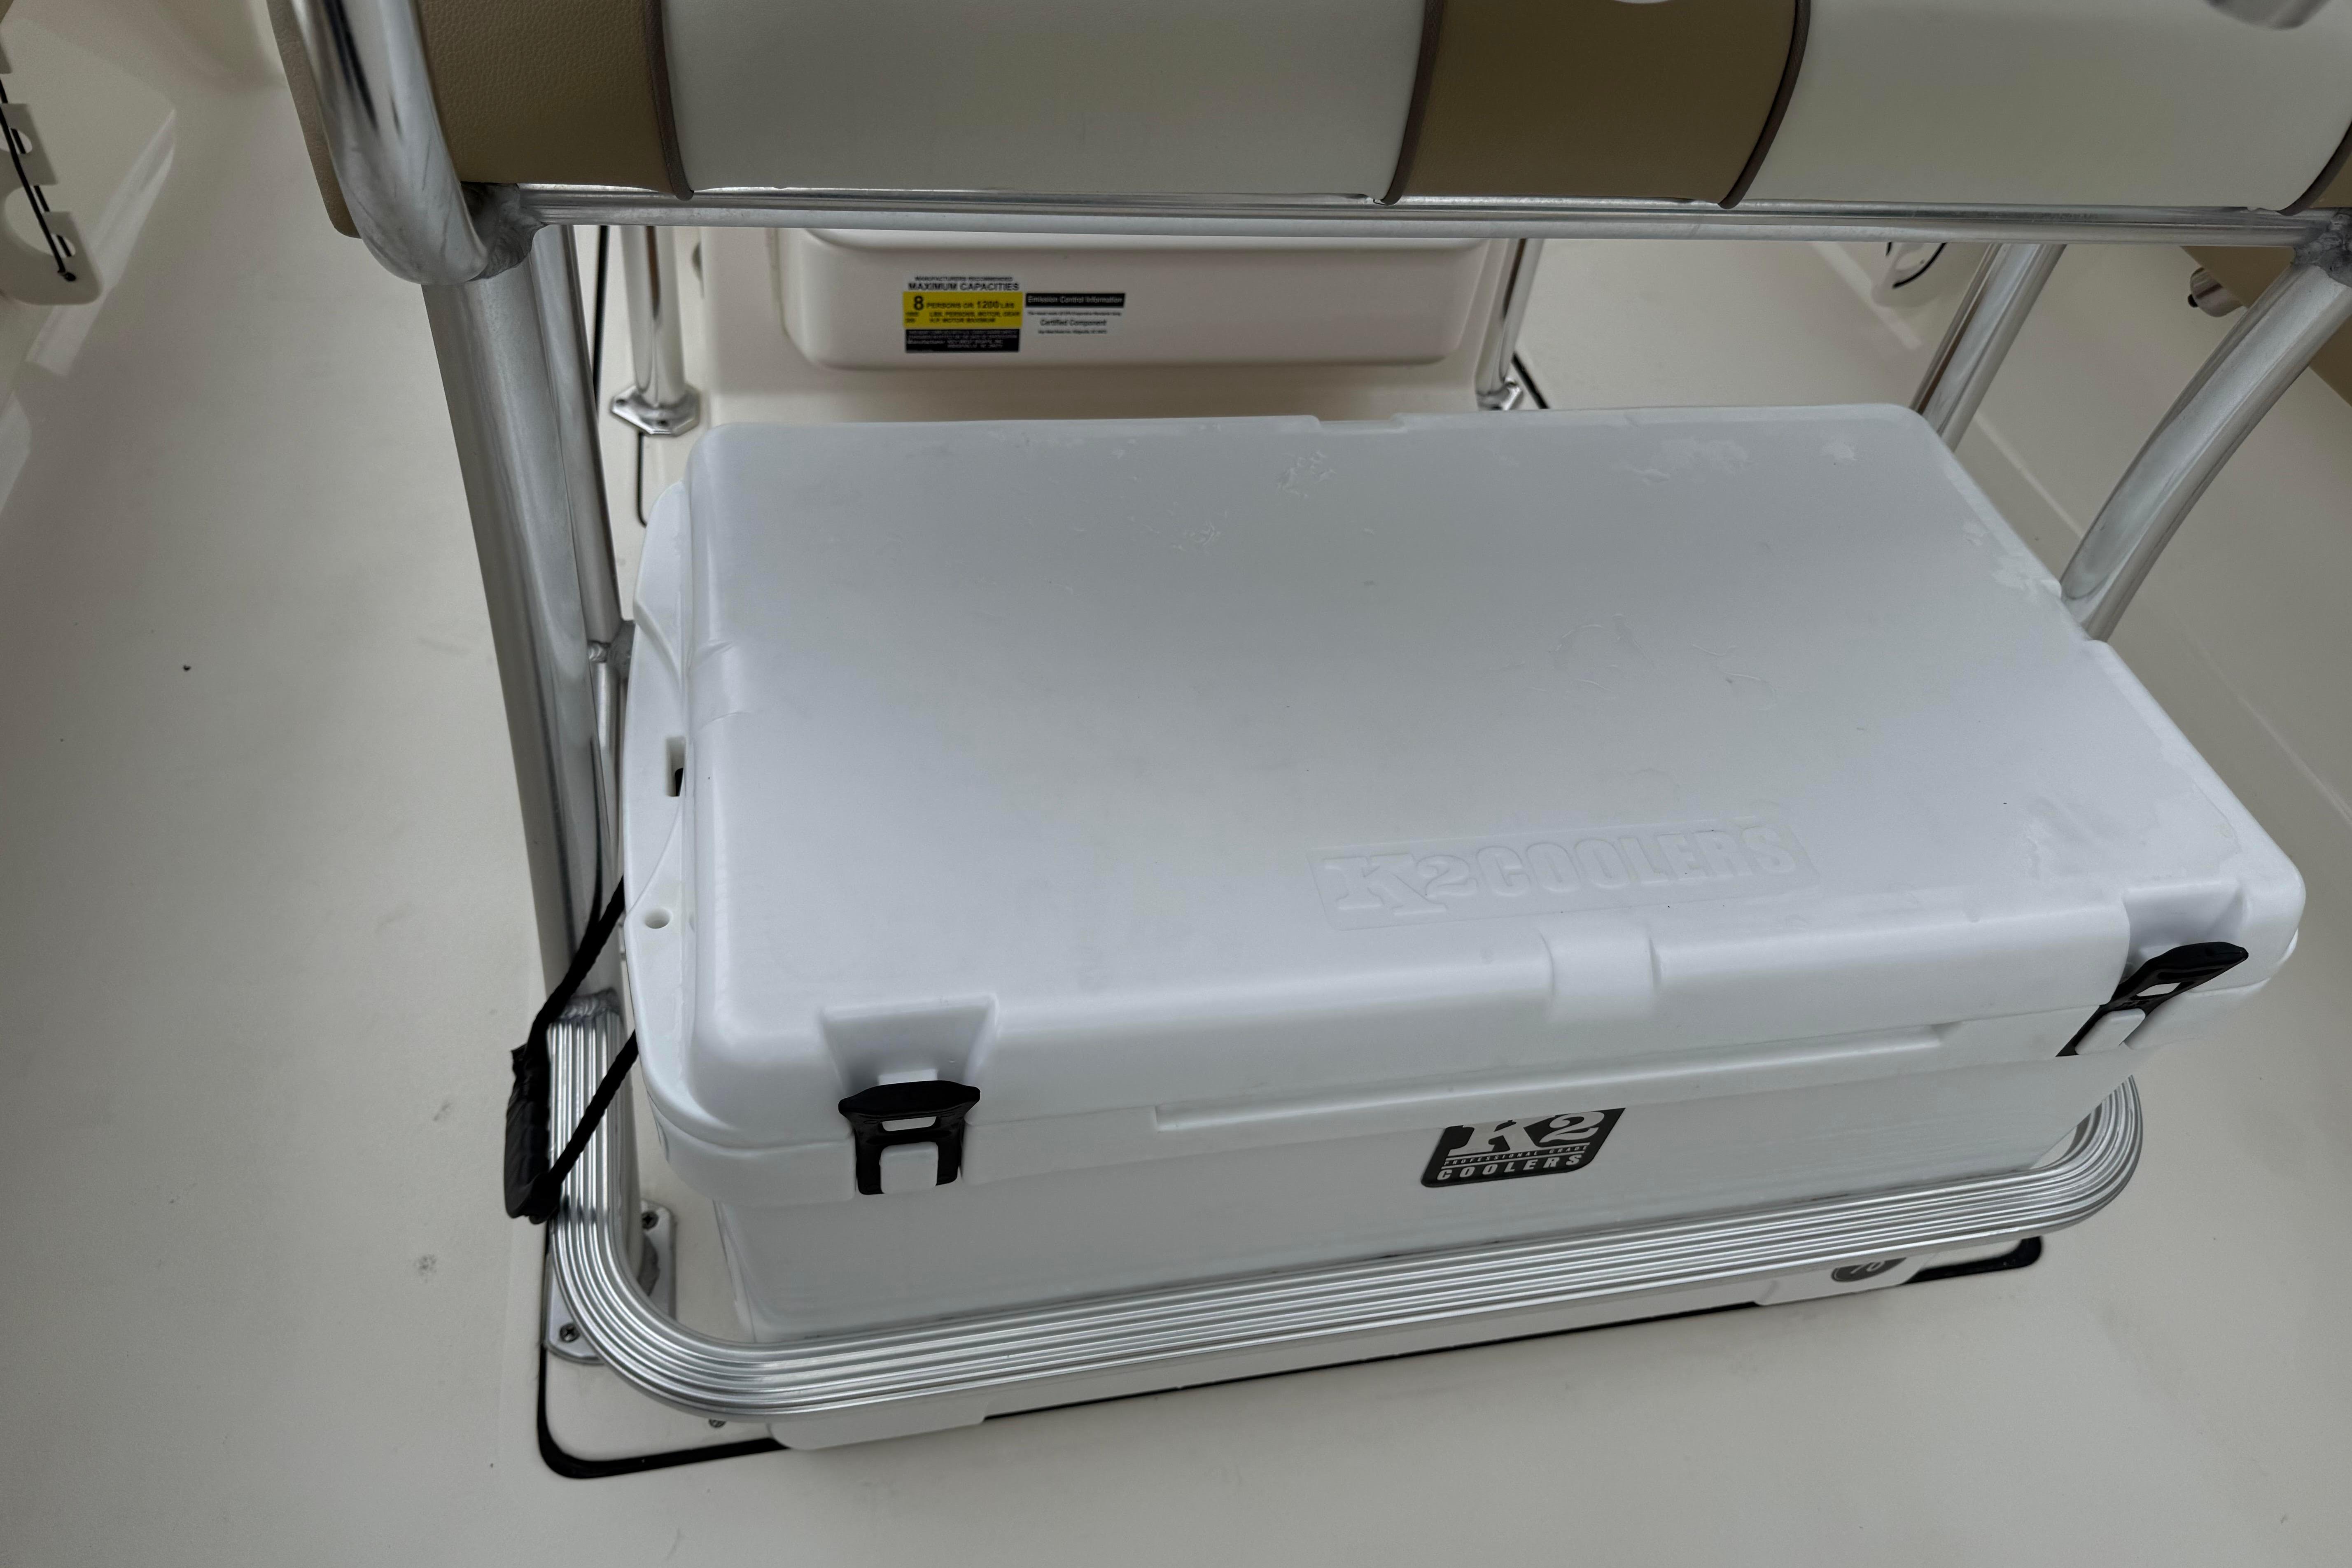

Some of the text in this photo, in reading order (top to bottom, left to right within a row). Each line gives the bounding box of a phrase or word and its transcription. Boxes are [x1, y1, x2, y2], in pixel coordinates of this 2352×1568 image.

[908, 282, 1019, 291] MAXIMUM CAPACITIES
[913, 296, 924, 310] 8
[1447, 1111, 1605, 1157] K2
[1444, 1145, 1588, 1166] PROFESSIONAL GRADE
[1437, 1154, 1582, 1181] COOLERS
